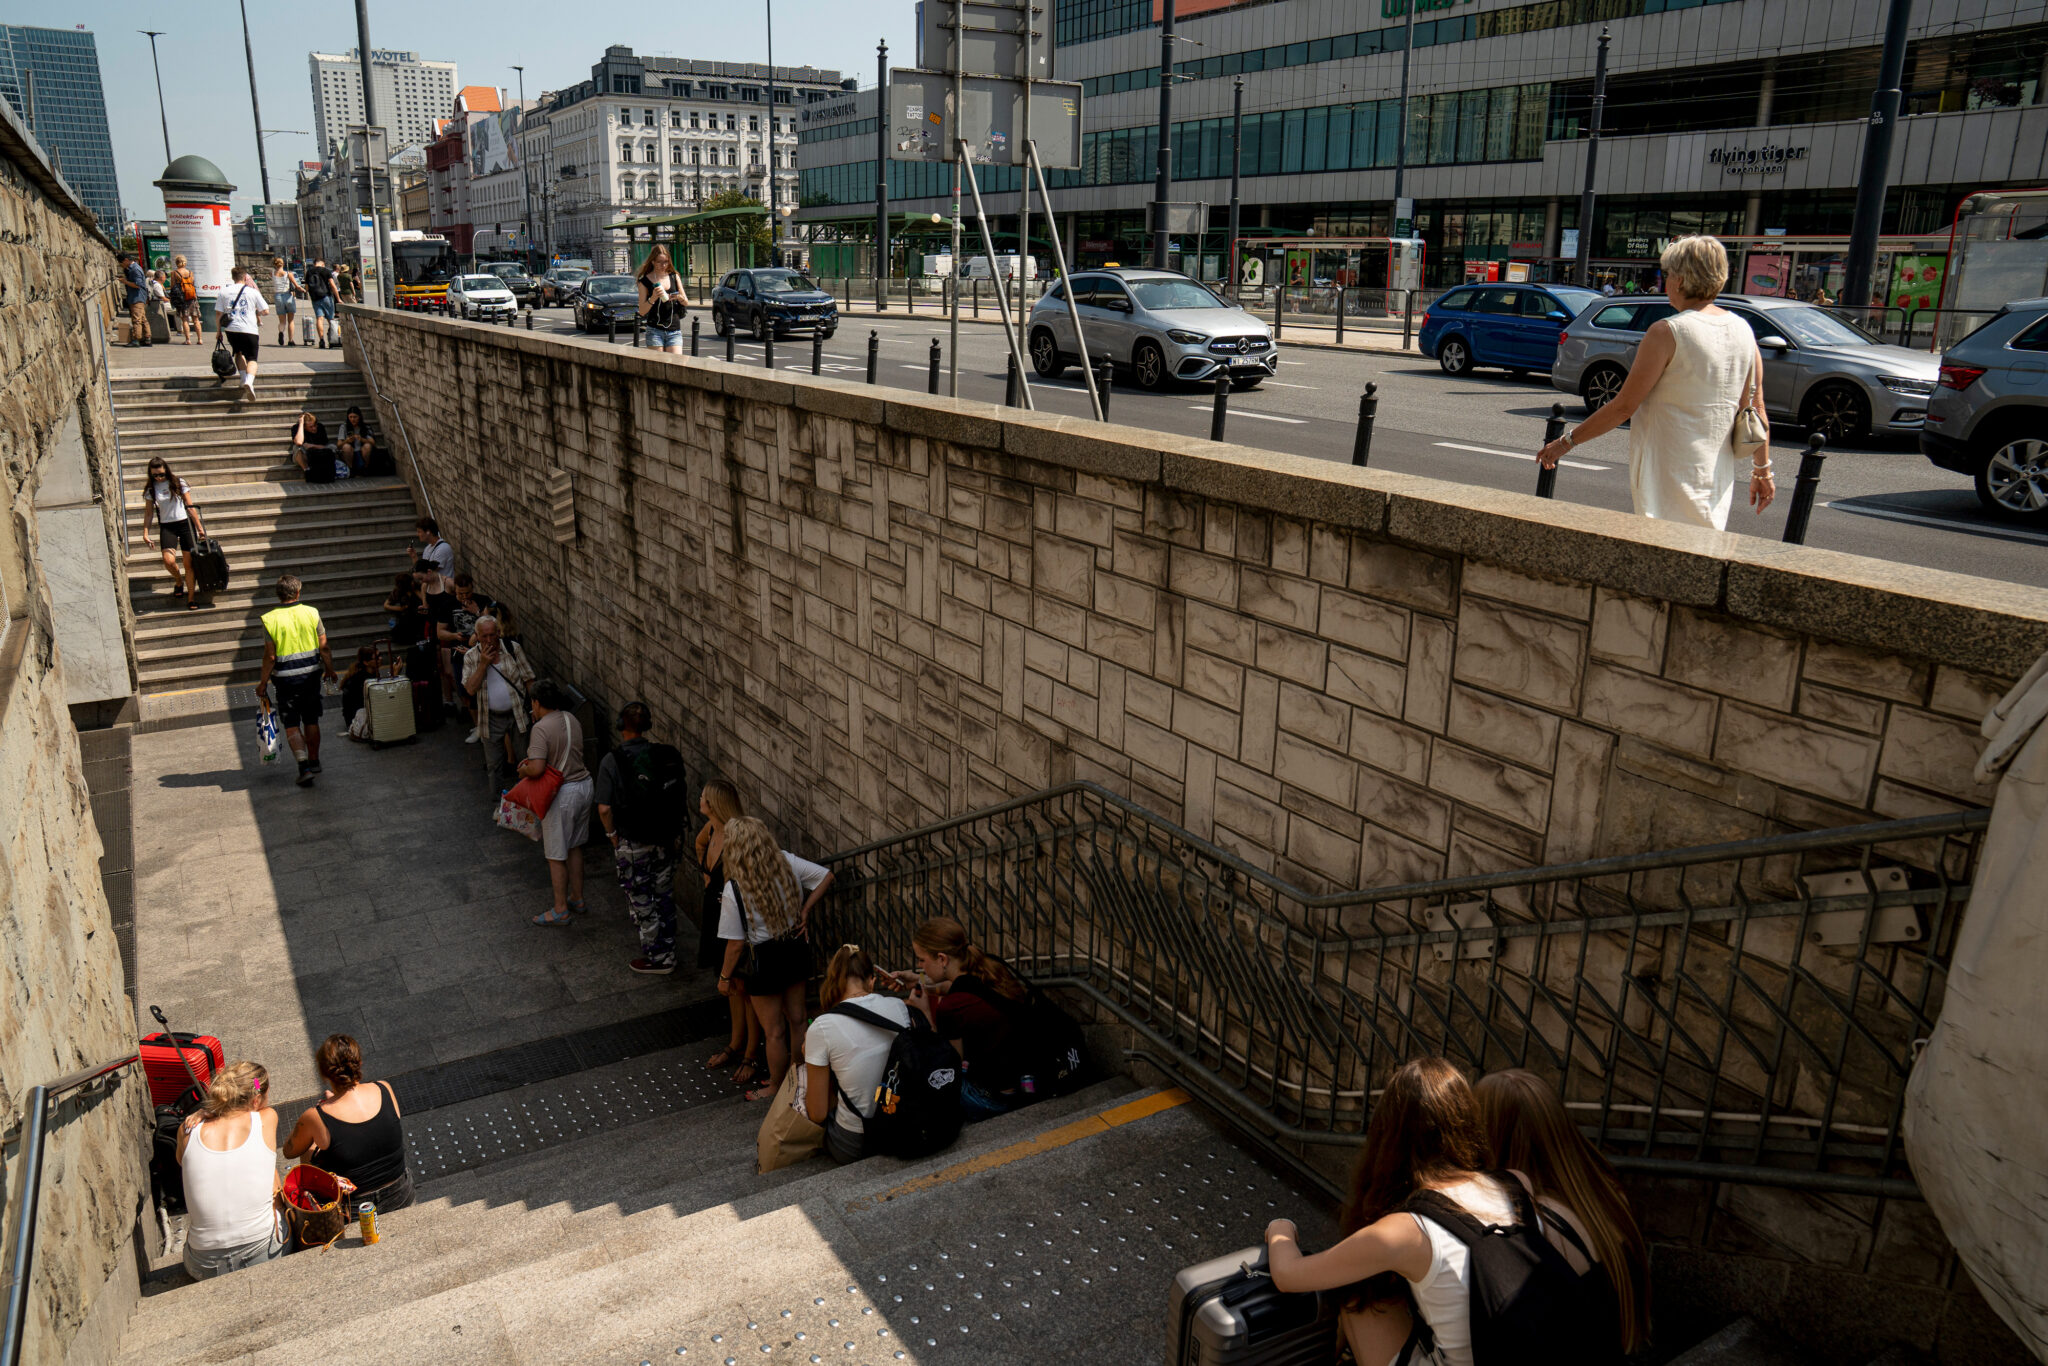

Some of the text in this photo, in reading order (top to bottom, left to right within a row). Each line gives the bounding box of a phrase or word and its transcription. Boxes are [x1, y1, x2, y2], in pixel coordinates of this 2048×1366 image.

[1710, 145, 1805, 166] flying tiger
[1726, 165, 1784, 175] copenhagen
